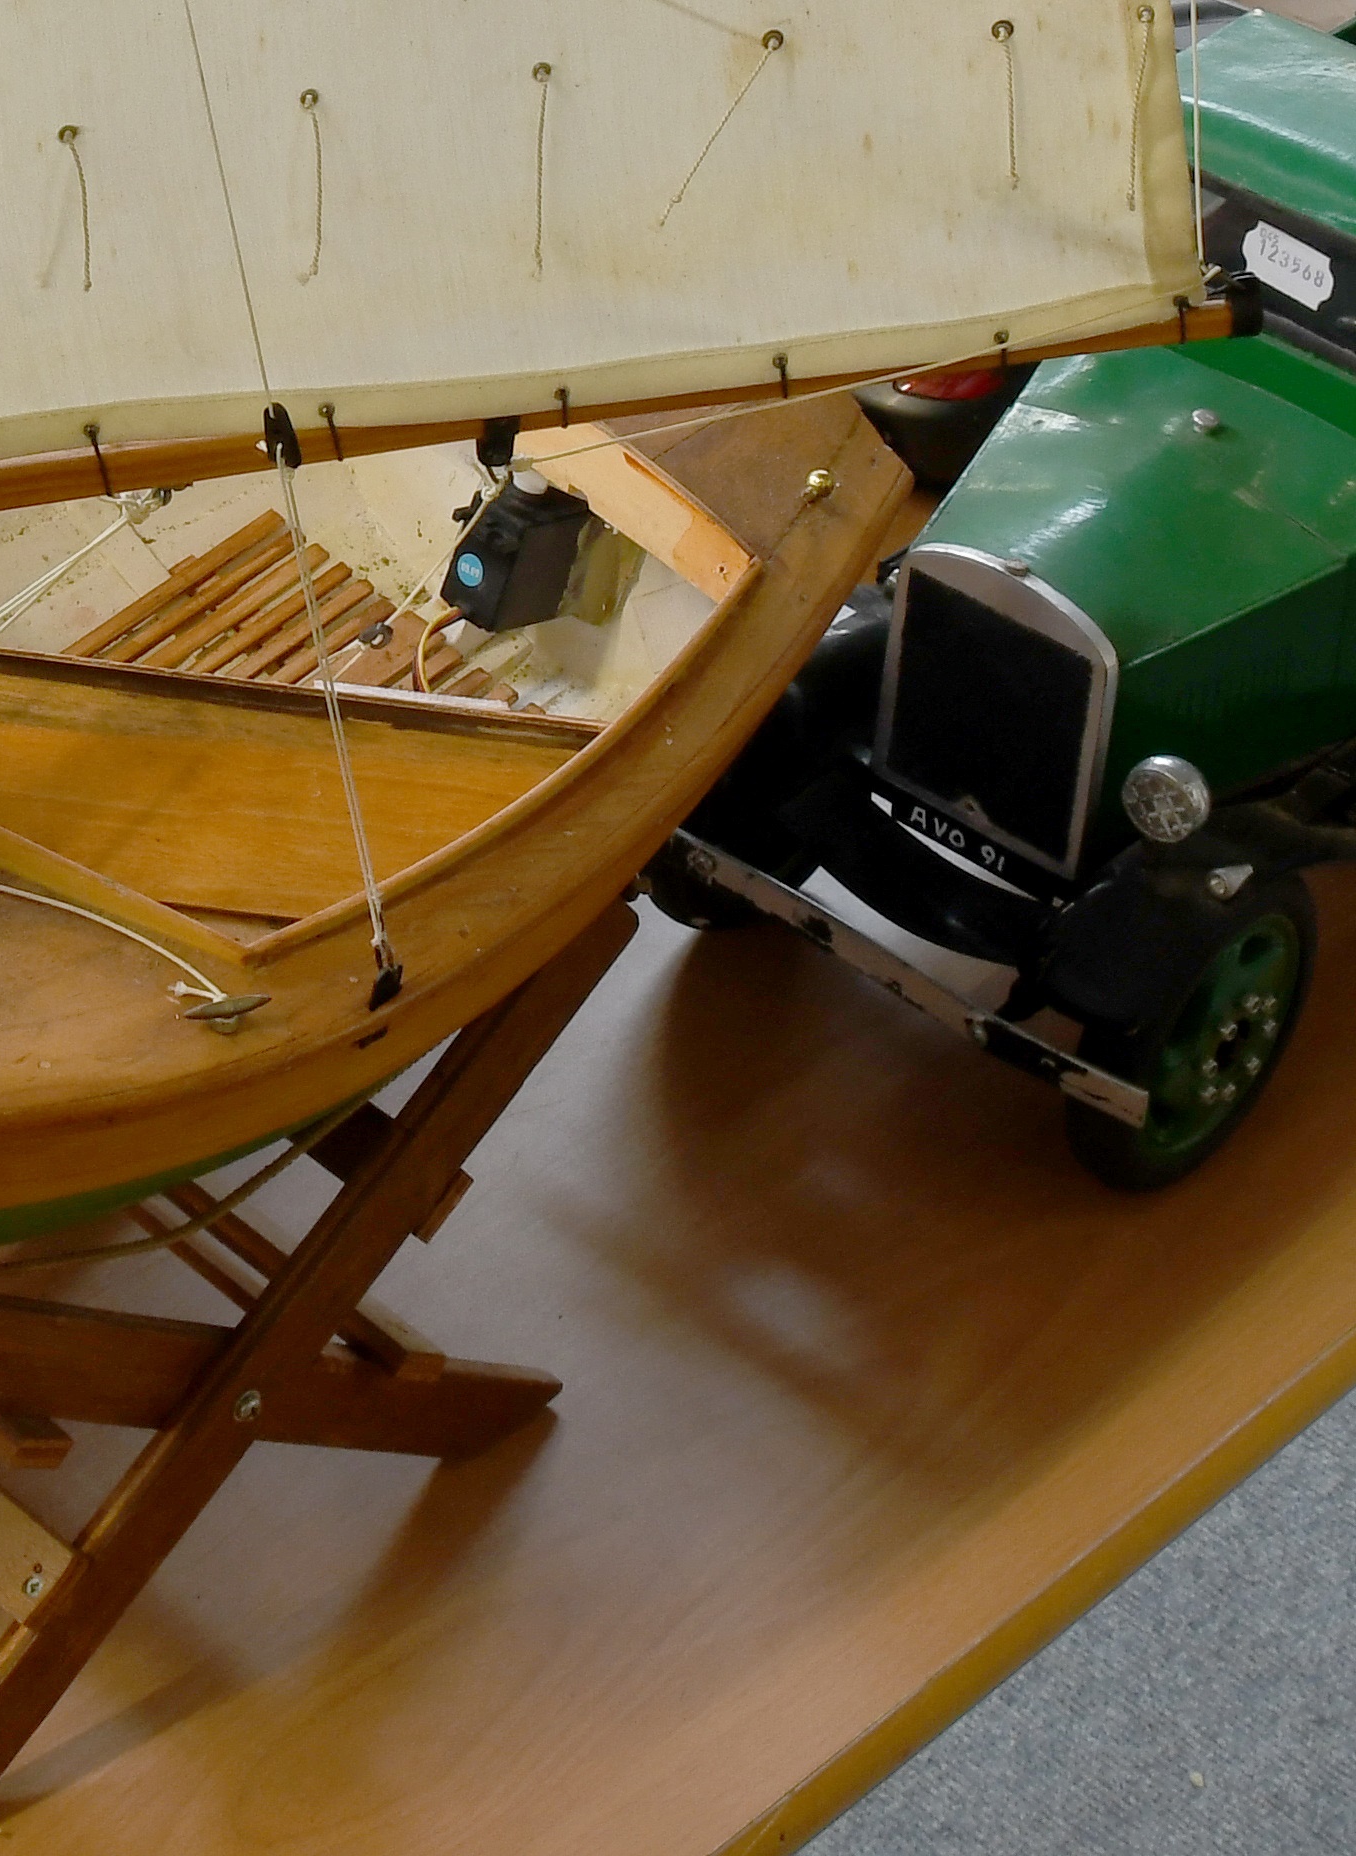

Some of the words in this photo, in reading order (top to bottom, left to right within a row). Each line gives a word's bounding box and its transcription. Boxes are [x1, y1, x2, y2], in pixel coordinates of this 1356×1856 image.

[1259, 238, 1325, 288] 123568
[910, 805, 966, 848] AVO
[980, 844, 1005, 872] 91
